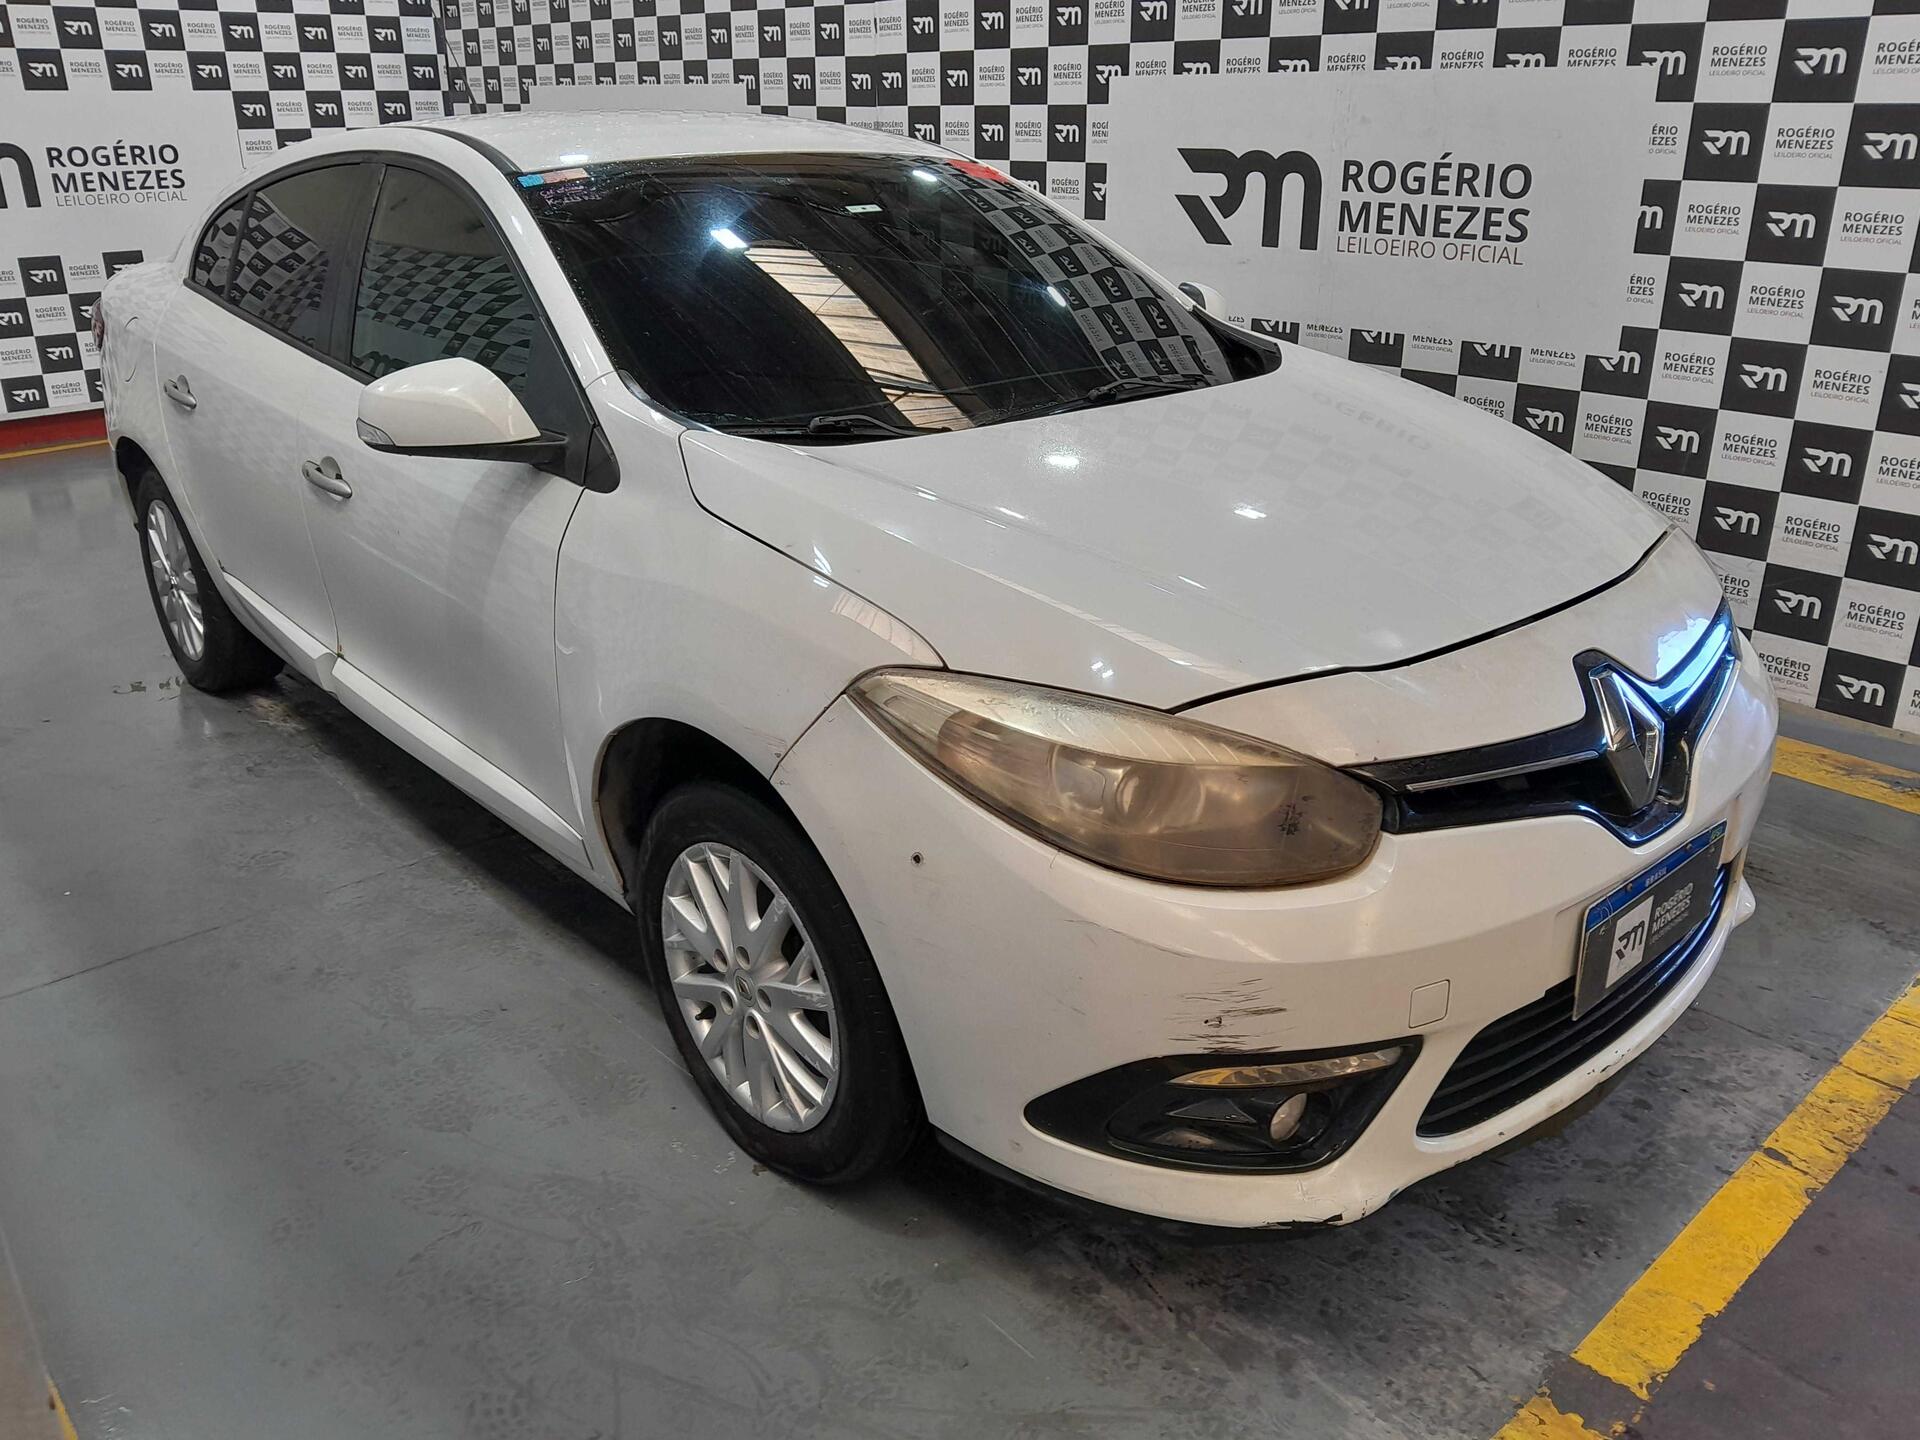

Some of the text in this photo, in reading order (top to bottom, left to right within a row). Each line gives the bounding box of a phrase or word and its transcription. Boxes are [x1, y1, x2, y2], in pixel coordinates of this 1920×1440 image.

[1016, 5, 1043, 15] ROGÉRIO
[1095, 0, 1125, 9] ROGÉRIO
[1182, 3, 1216, 13] MENEZES
[1016, 14, 1043, 23] MENEZES
[1095, 9, 1125, 18] MENEZES
[1441, 49, 1484, 61] ROGÉRIO
[1568, 46, 1617, 58] ROGÉRIO
[1712, 44, 1767, 56] ROGÉRIO
[1136, 59, 1167, 69] ROGÉRIO
[1226, 56, 1261, 66] ROGÉRIO
[1327, 53, 1366, 65] ROGÉRIO
[1710, 57, 1766, 67] MENEZES
[1053, 63, 1082, 71] ROGÉRIO
[1053, 71, 1082, 79] MENEZES
[1015, 121, 1042, 129] ROGÉRIO
[1777, 126, 1835, 138] ROGÉRIO
[1015, 128, 1042, 137] MENEZES
[1775, 138, 1834, 150] MENEZES
[46, 139, 179, 168] ROGÉRIO
[51, 169, 185, 194] MENEZES
[1052, 178, 1079, 186] ROGÉRIO
[1342, 152, 1532, 199] ROGÉRIO
[1051, 186, 1079, 194] MENEZES
[55, 190, 188, 207] LEILOEIRO OFICIAL
[1688, 203, 1741, 216] ROGÉRIO
[1337, 200, 1530, 243] MENEZES
[1686, 214, 1740, 226] MENEZES
[1844, 211, 1904, 224] ROGÉRIO
[1842, 223, 1903, 236] MENEZES
[1337, 236, 1523, 265] LEILOEIRO OFICIAL
[1750, 285, 1805, 299] ROGÉRIO
[1749, 296, 1804, 311] MENEZES
[1663, 352, 1715, 366] ROGÉRIO
[1663, 362, 1714, 376] MENEZES
[1814, 369, 1872, 384] ROGÉRIO
[1812, 380, 1870, 397] MENEZES
[1463, 396, 1505, 411] ROGÉRIO
[1586, 413, 1633, 427] ROGÉRIO
[1584, 422, 1633, 437] MENEZES
[1724, 433, 1777, 448] ROGÉRIO
[1723, 443, 1777, 459] MENEZES
[1642, 490, 1691, 506] ROGÉRIO
[1786, 516, 1840, 533] ROGÉRIO
[1783, 526, 1840, 545] MENEZES
[1849, 601, 1906, 621] ROGÉRIO
[1847, 611, 1906, 632] MENEZES
[1758, 652, 1811, 673] ROGÉRIO
[1654, 883, 1694, 920] ROGÉRIO
[1651, 895, 1692, 934] MENEZES
